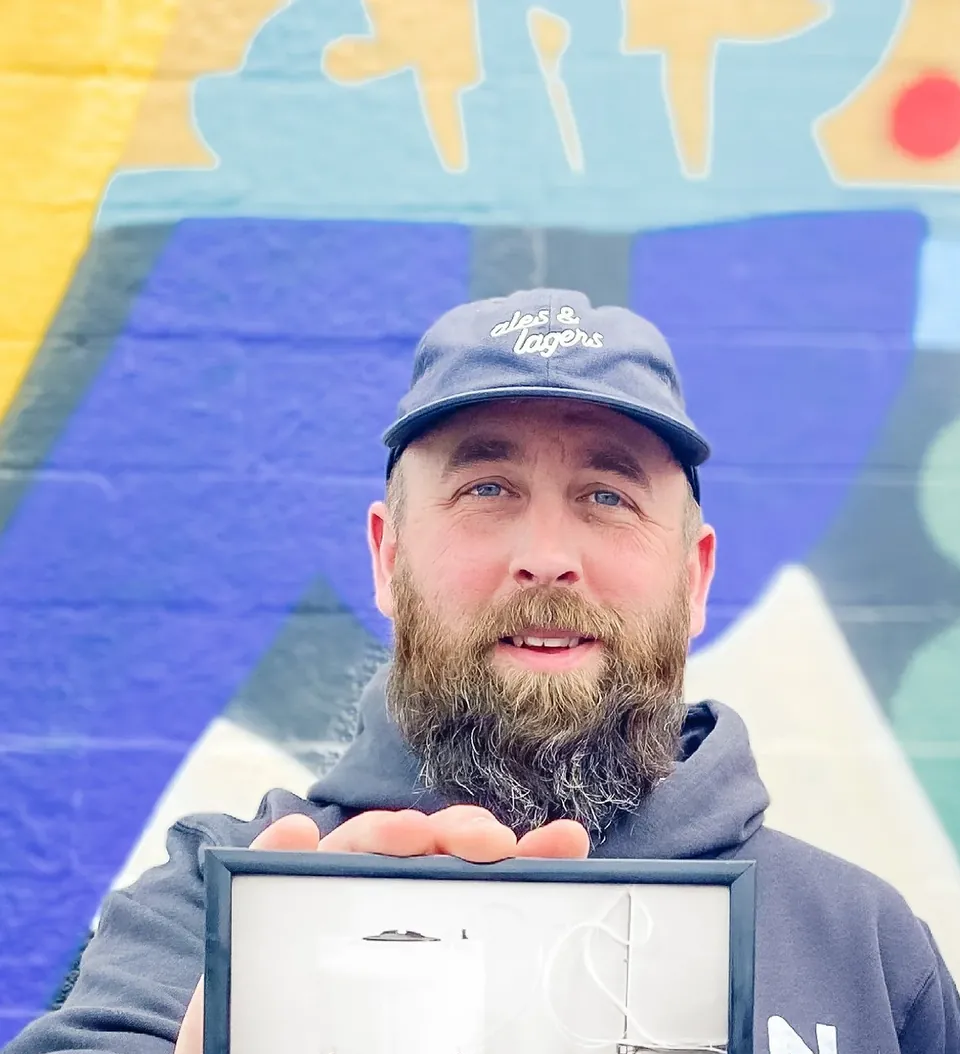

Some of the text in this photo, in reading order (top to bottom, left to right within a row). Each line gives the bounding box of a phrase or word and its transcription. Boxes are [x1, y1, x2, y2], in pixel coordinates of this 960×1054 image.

[489, 305, 581, 338] ales &
[513, 327, 604, 358] lagers
